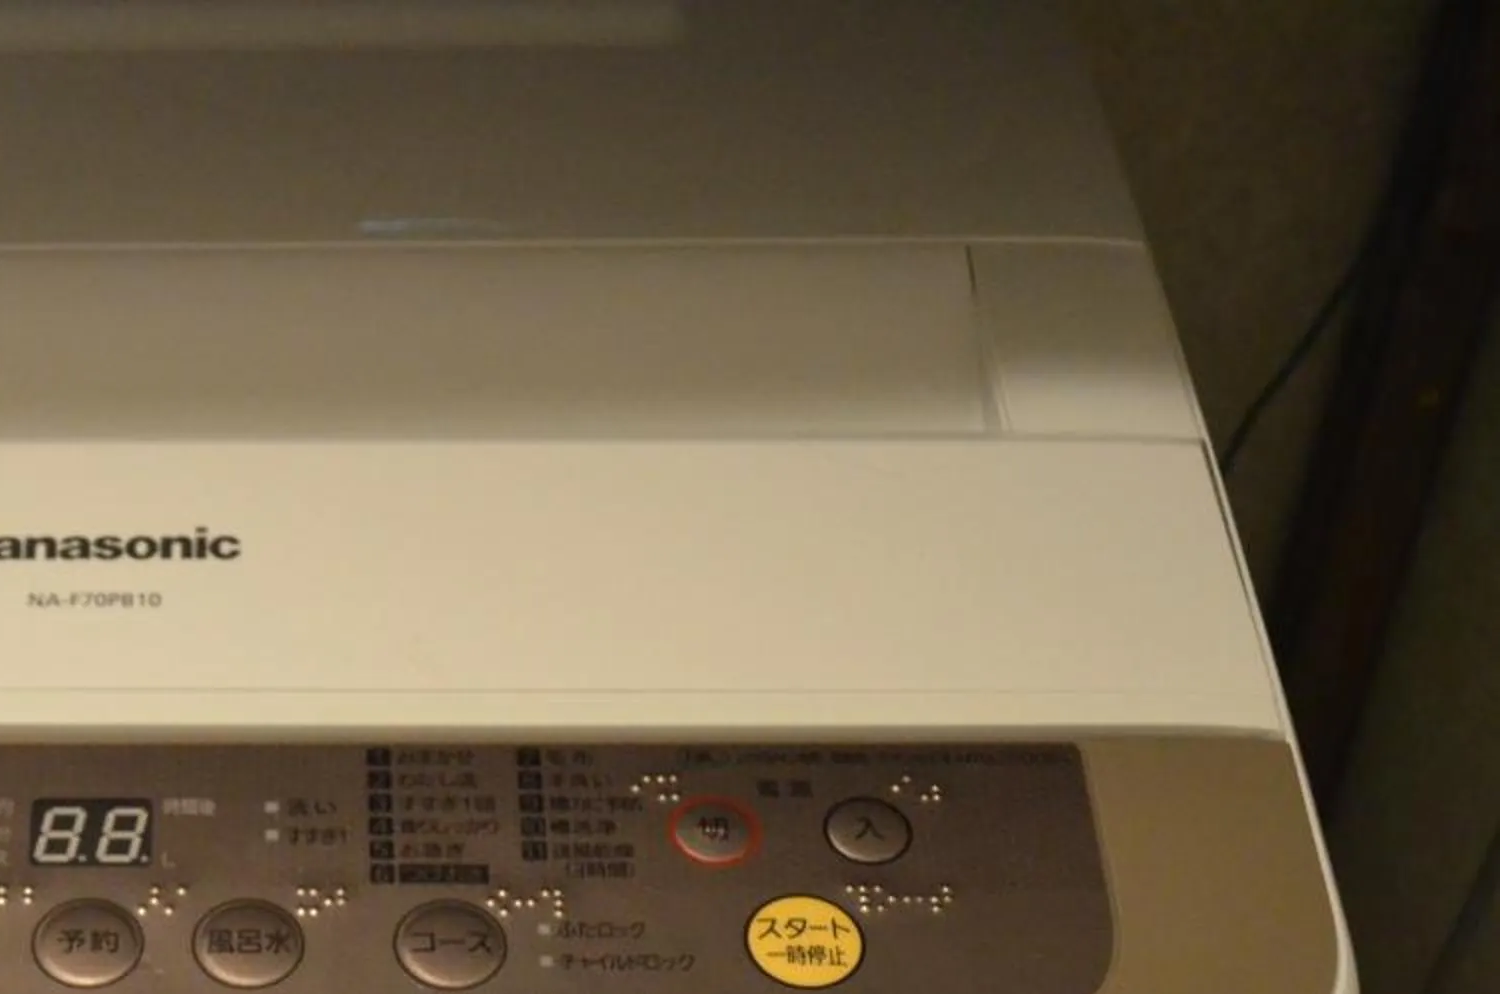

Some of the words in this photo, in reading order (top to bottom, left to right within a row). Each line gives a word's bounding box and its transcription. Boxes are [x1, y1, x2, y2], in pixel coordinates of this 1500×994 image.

[854, 818, 885, 841] 入
[56, 928, 121, 954] 予約
[206, 928, 293, 954] 風呂水
[756, 917, 851, 941] スタート
[411, 931, 494, 954] コース
[766, 944, 849, 969] 一時停止
